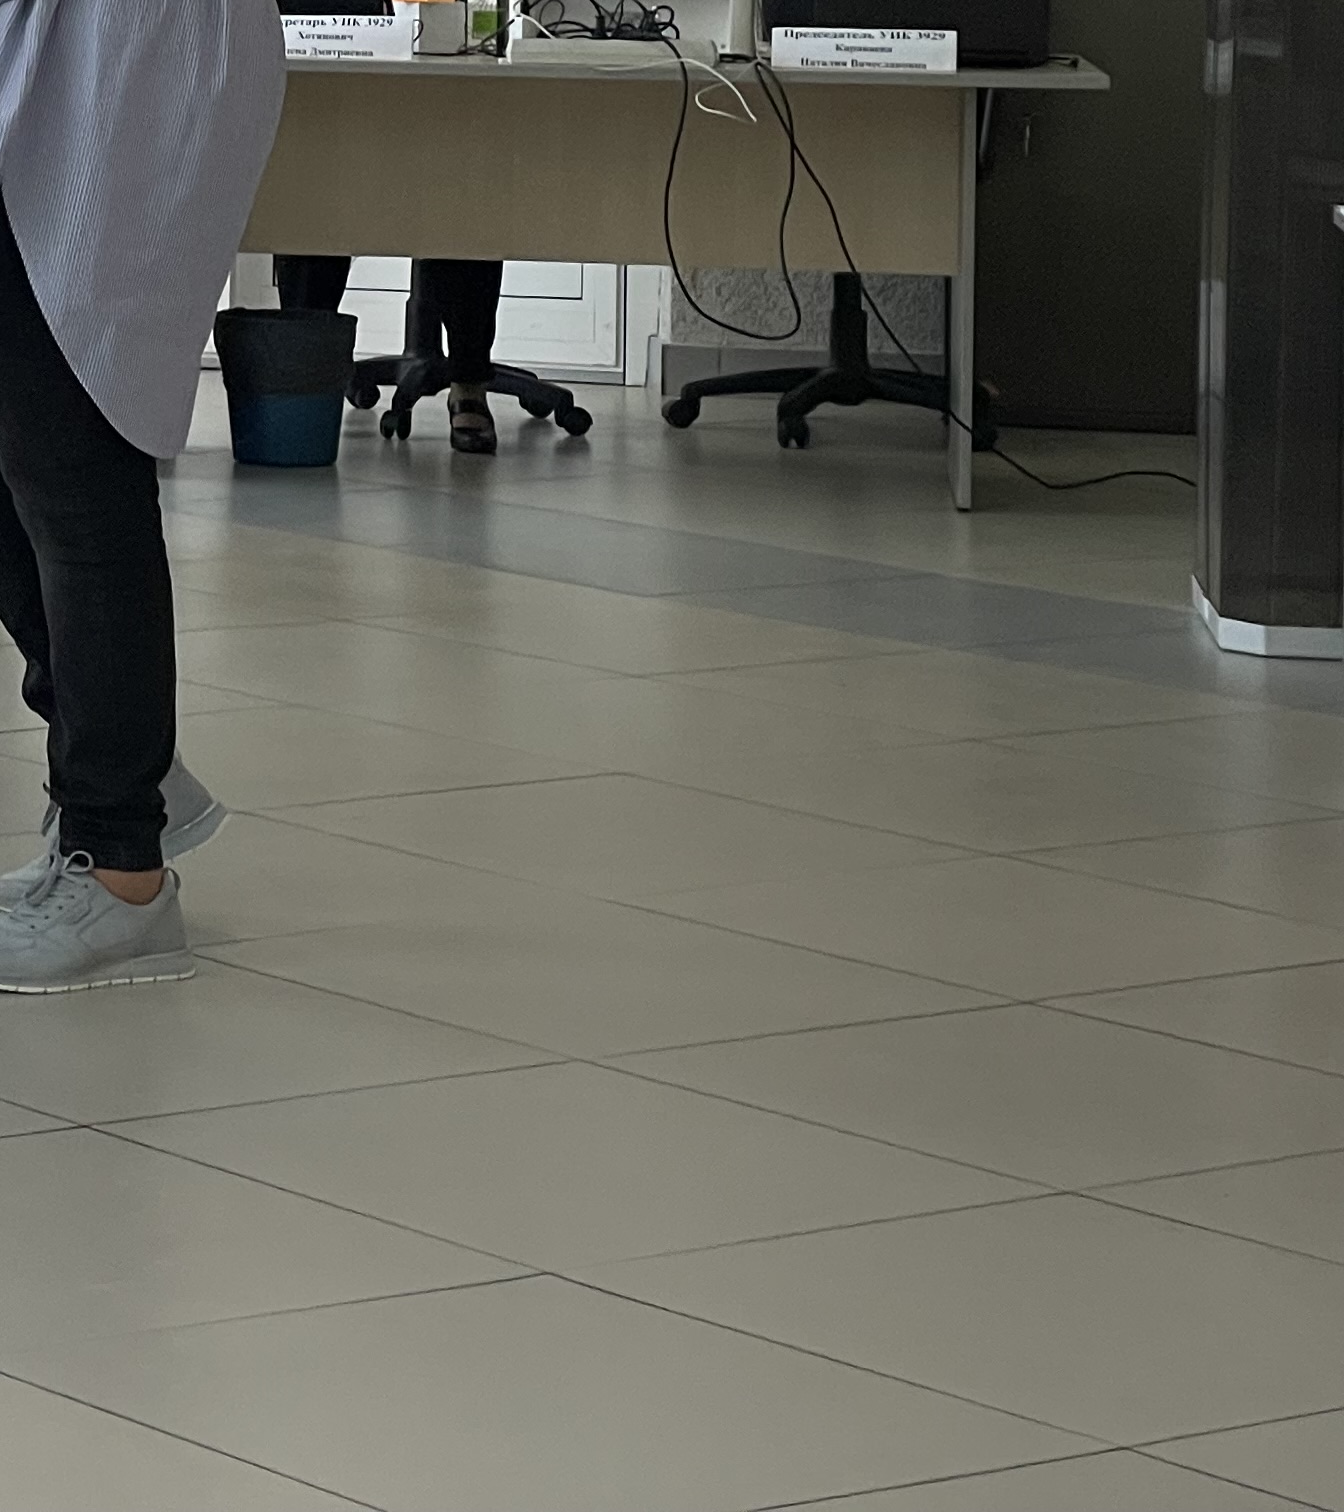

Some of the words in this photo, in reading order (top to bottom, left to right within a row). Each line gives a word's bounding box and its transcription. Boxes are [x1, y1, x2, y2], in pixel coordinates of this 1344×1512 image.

[332, 17, 360, 27] УИК
[365, 17, 393, 28] 3929
[784, 29, 875, 40] Председатель
[880, 30, 911, 40] УИК
[916, 31, 946, 41] 3929
